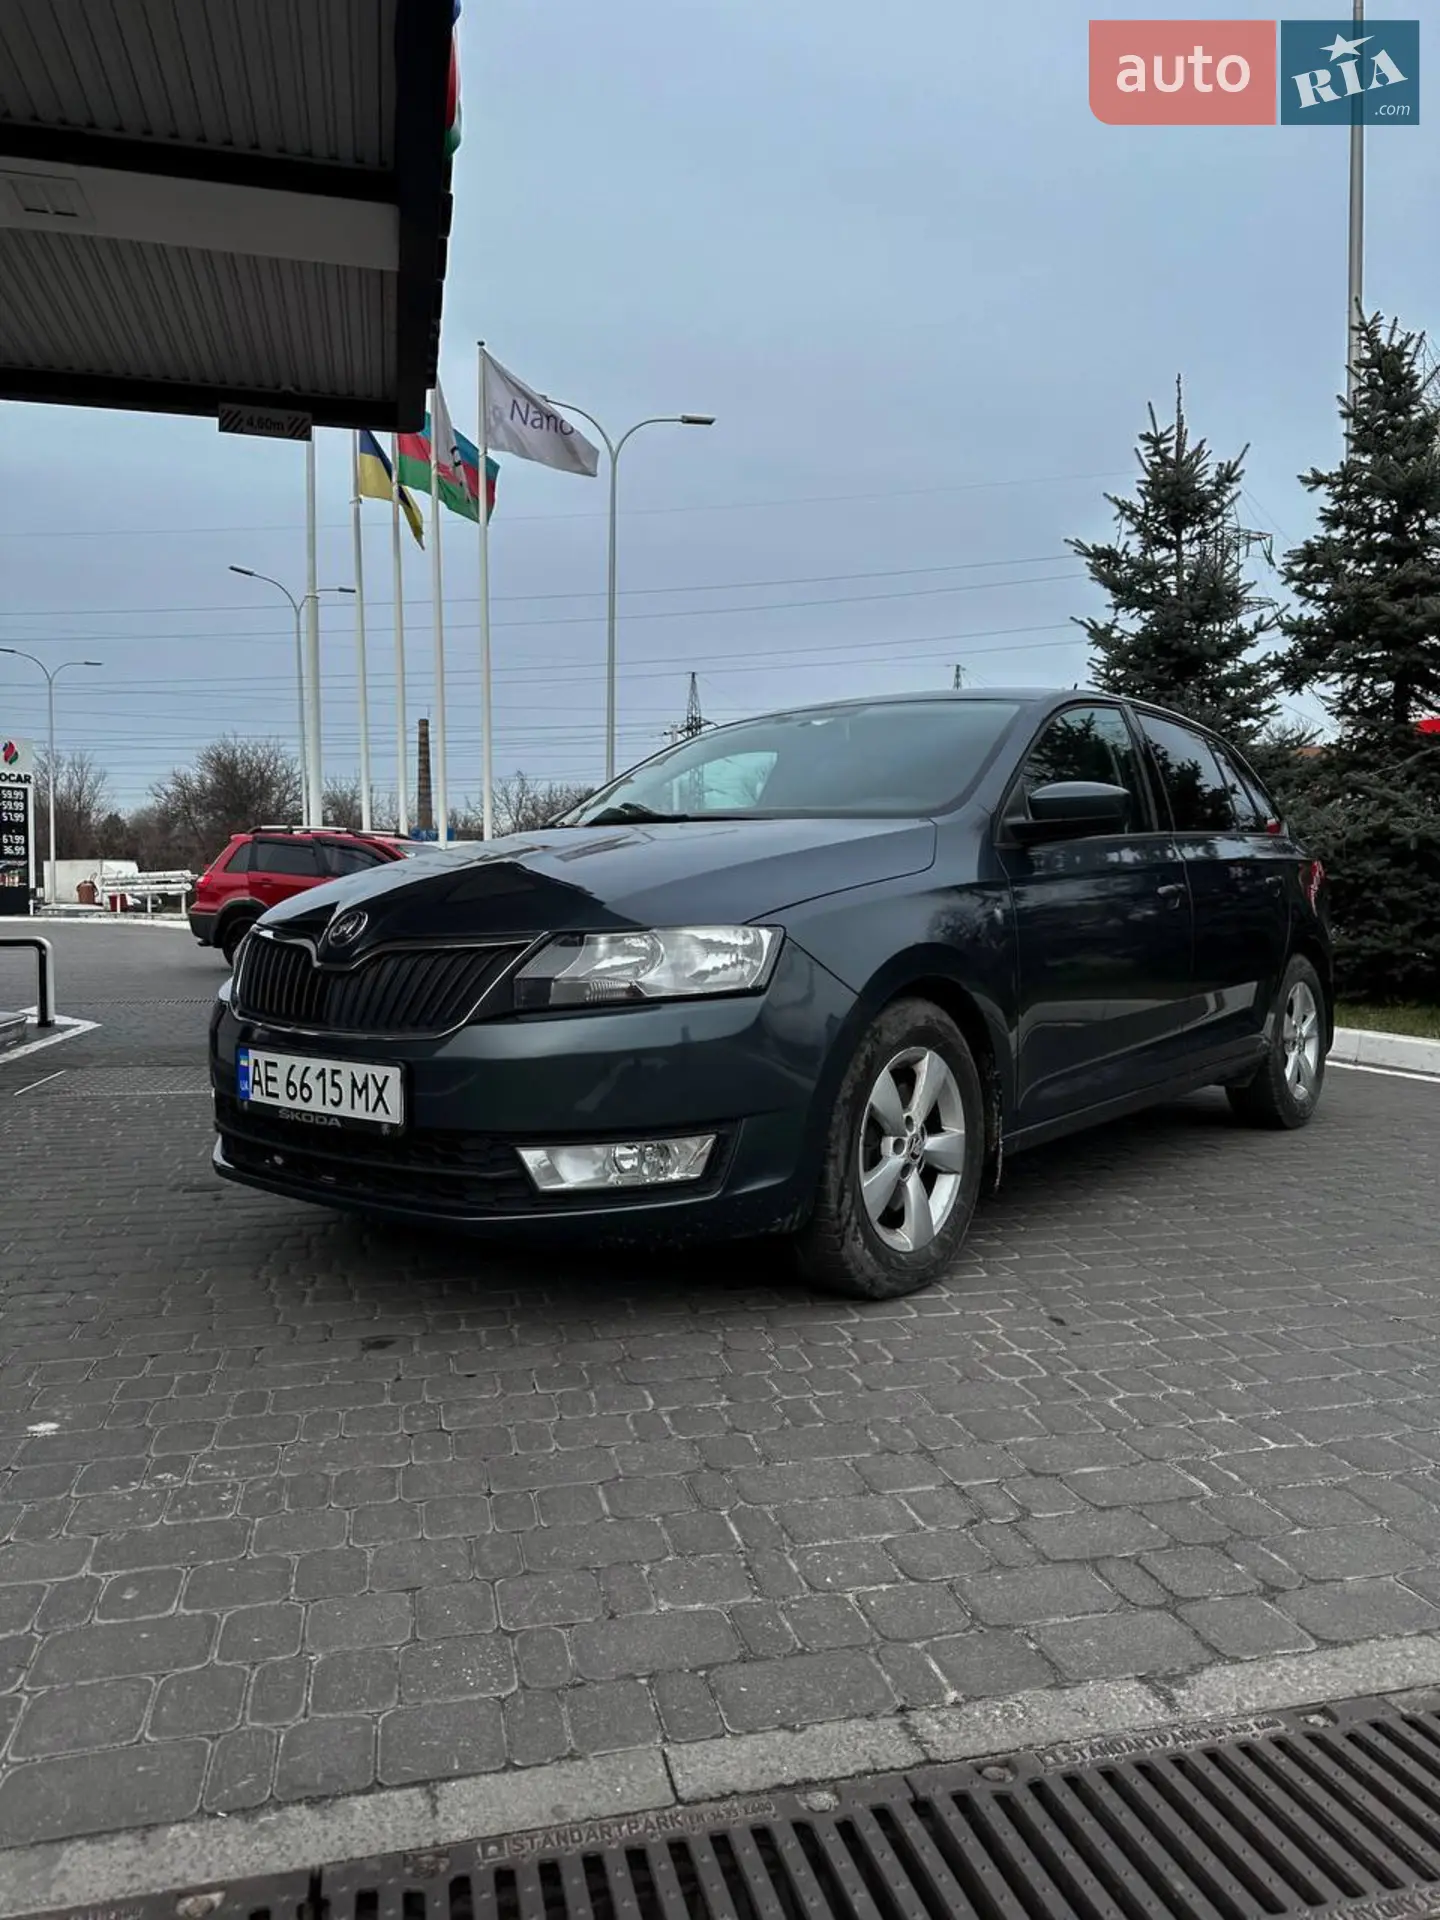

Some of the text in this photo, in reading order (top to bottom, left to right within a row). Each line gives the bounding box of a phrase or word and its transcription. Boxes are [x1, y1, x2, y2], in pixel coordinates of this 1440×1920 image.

[510, 399, 574, 436] Nano
[251, 1058, 390, 1115] AE 6615 MX
[510, 1812, 683, 1853] STANDARTPARK
